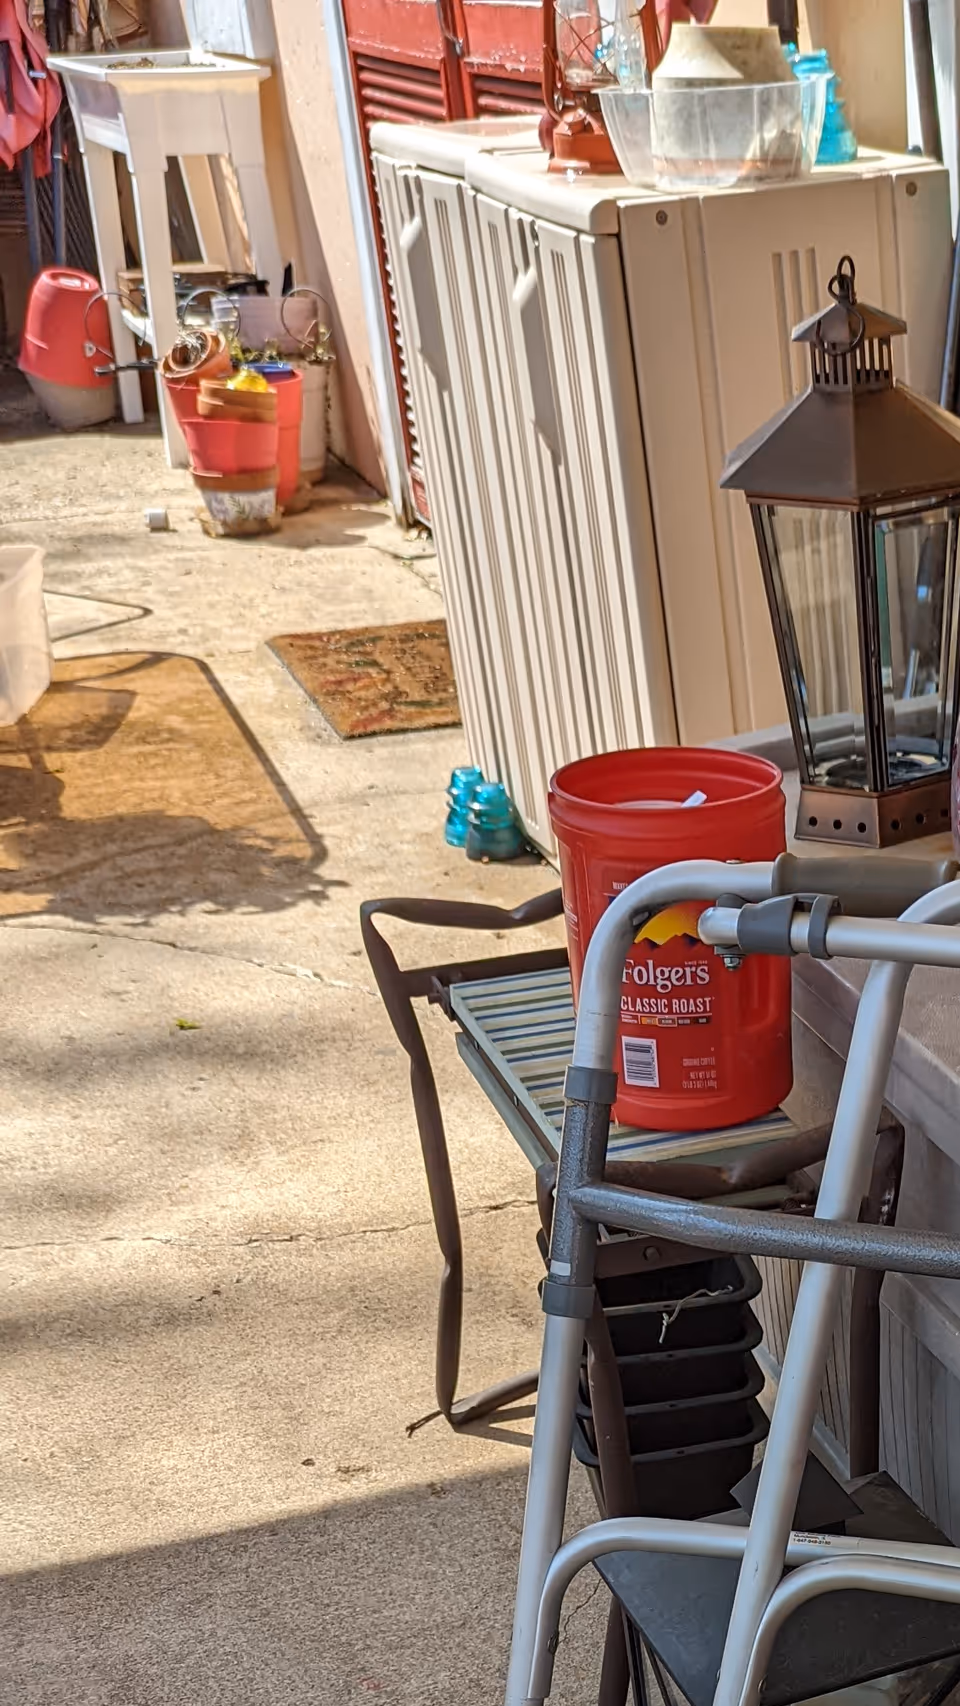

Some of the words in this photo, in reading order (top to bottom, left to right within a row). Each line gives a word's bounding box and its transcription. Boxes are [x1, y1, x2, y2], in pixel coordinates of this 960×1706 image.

[622, 959, 710, 993] Folgers
[620, 995, 668, 1013] CLASSIC
[671, 997, 711, 1014] ROAST
